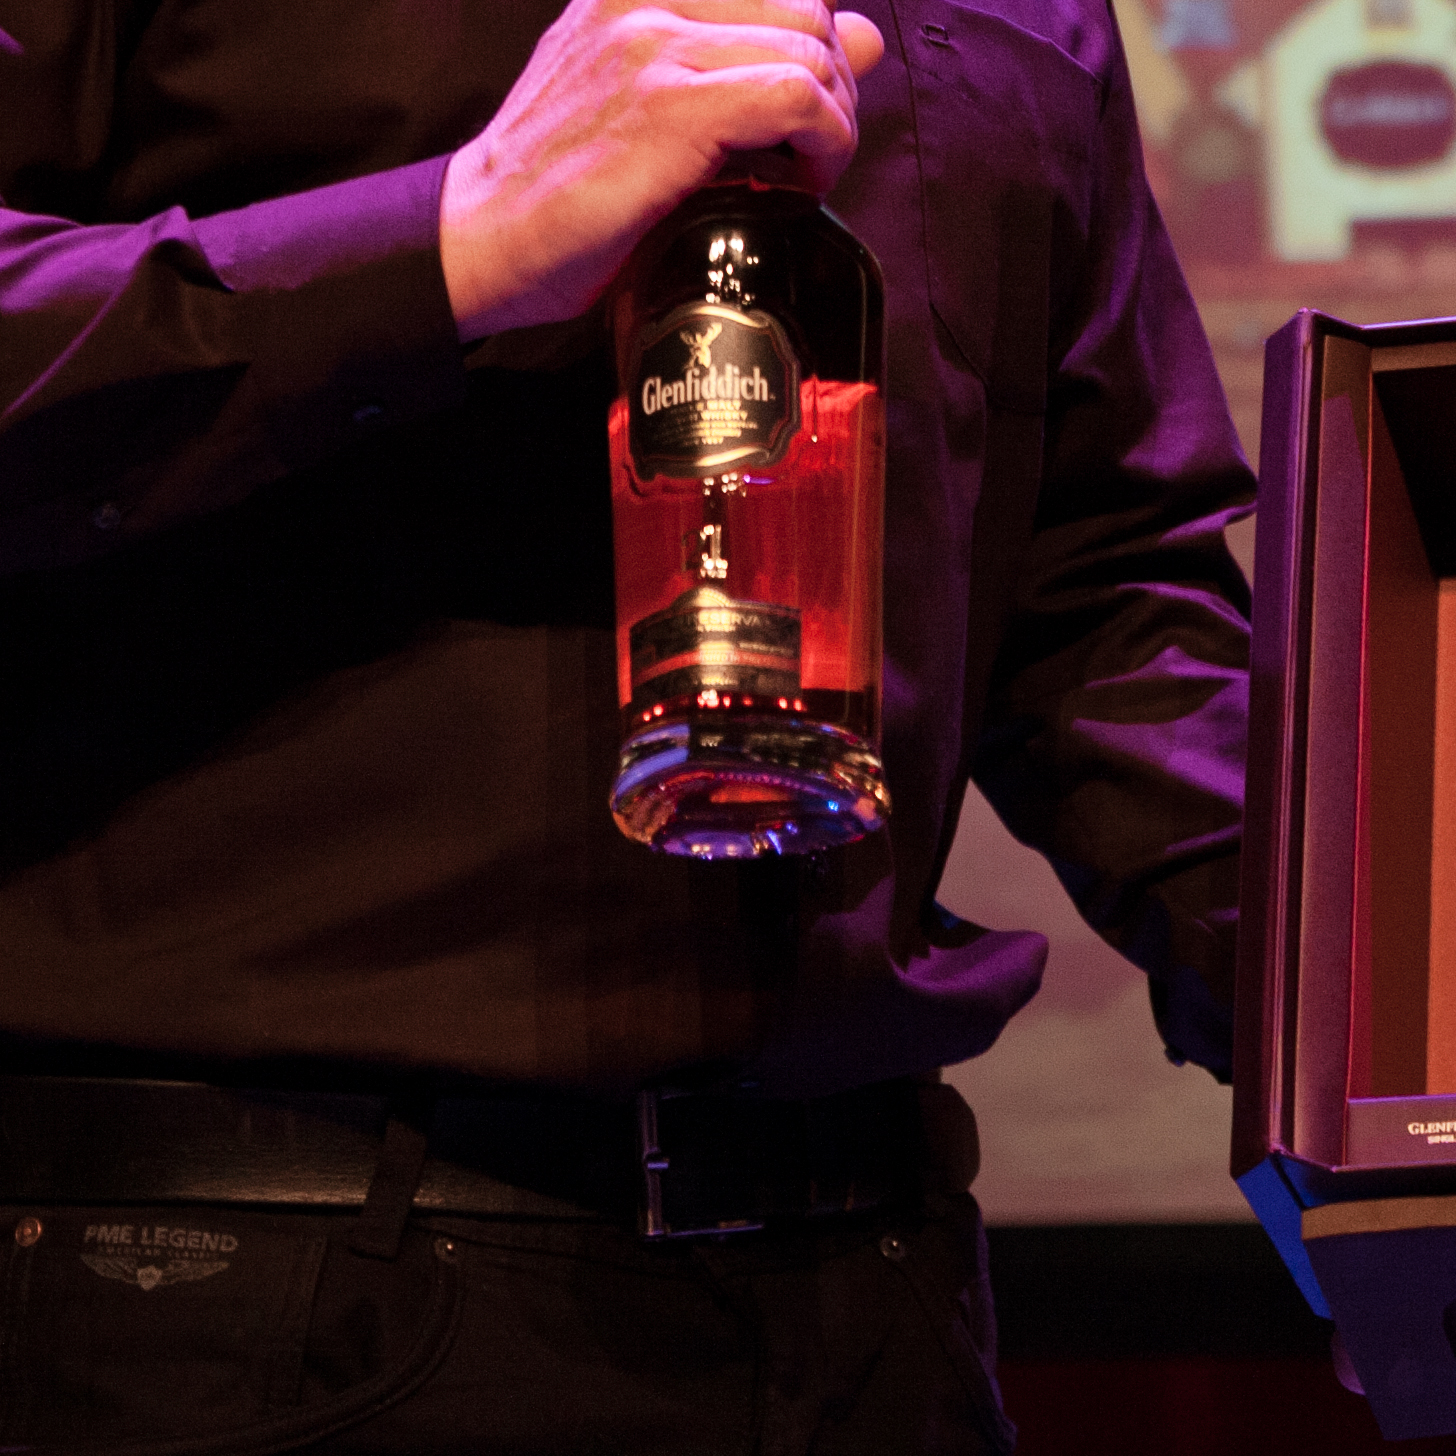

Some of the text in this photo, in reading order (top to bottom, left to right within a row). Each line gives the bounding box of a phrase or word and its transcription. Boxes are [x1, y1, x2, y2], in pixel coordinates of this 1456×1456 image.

[642, 363, 769, 415] Glenfiddich
[83, 1224, 239, 1253] PME LEGEND
